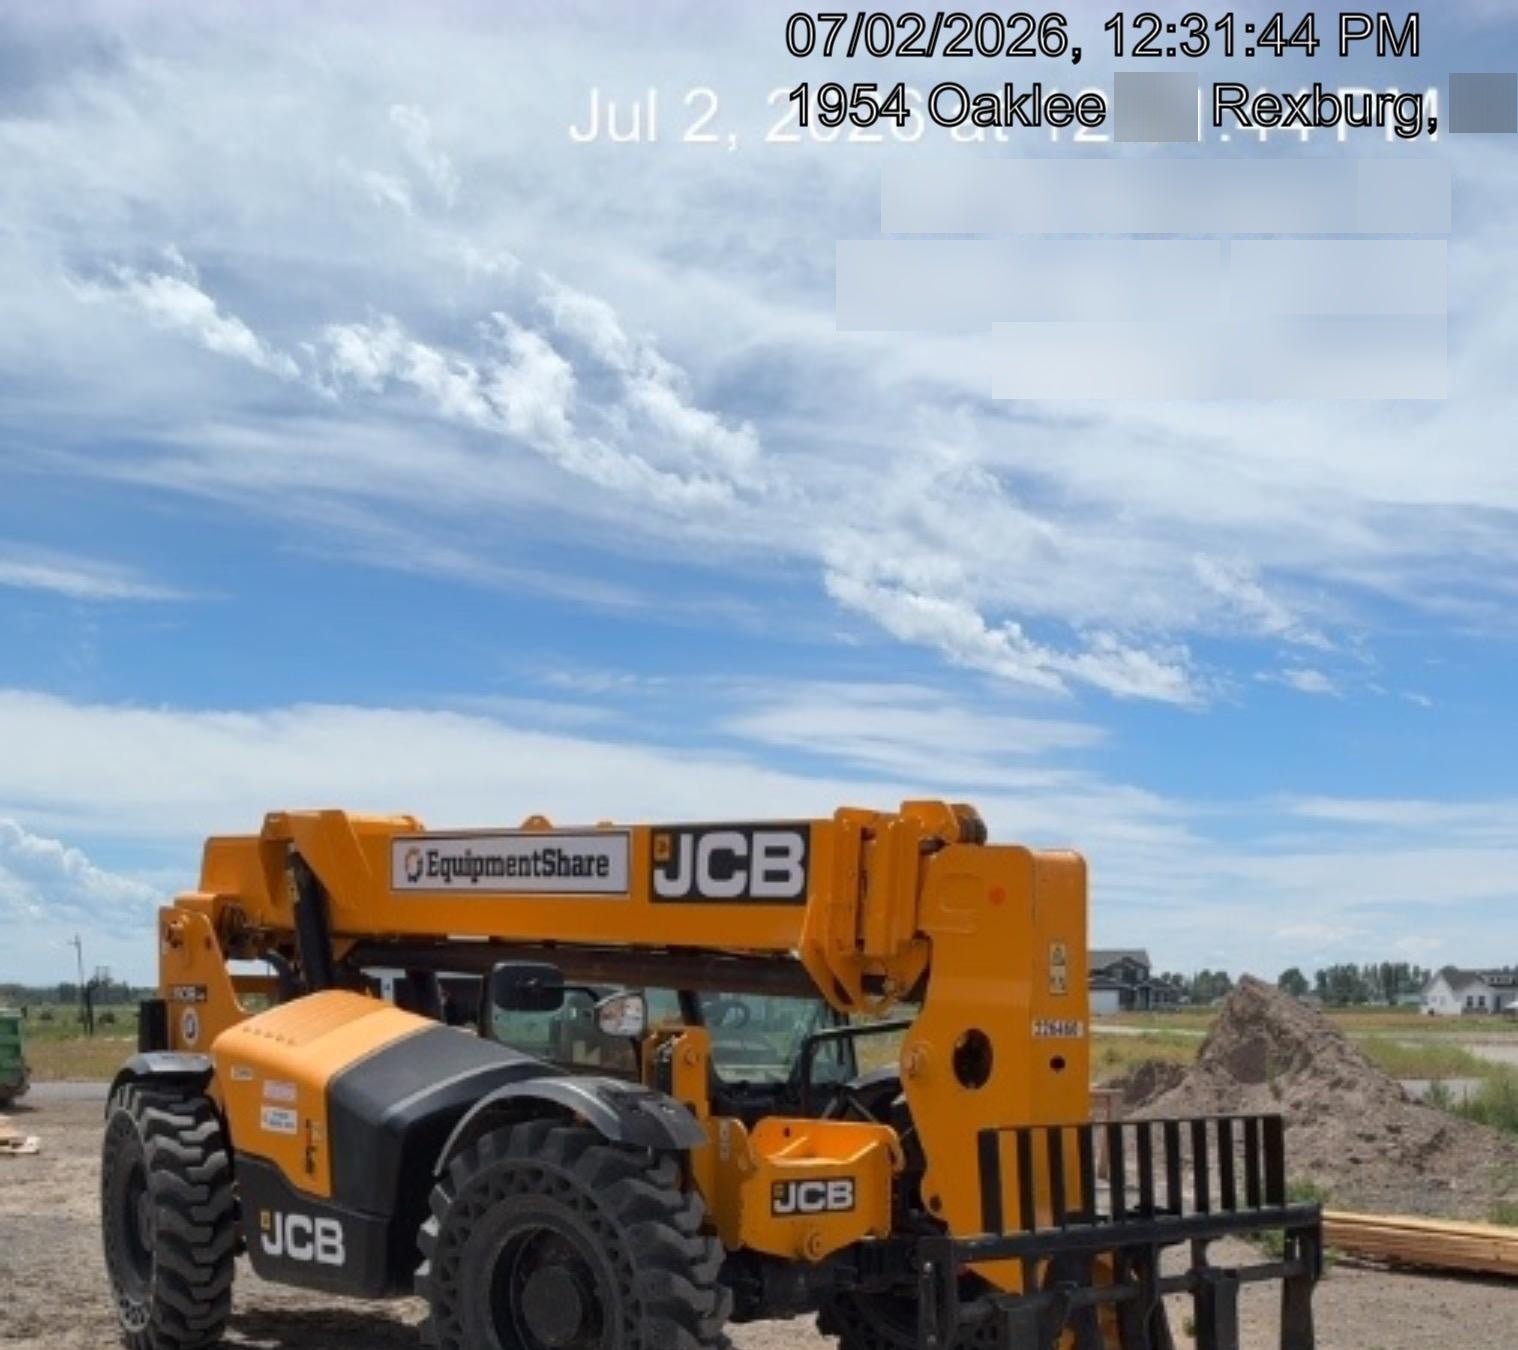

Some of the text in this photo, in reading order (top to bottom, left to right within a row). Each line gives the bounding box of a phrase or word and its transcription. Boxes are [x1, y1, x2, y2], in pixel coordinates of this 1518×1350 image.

[426, 848, 610, 884] EquipmentShare
[653, 831, 806, 898] JCB
[773, 1181, 854, 1213] JCB
[261, 1211, 346, 1267] JCB
